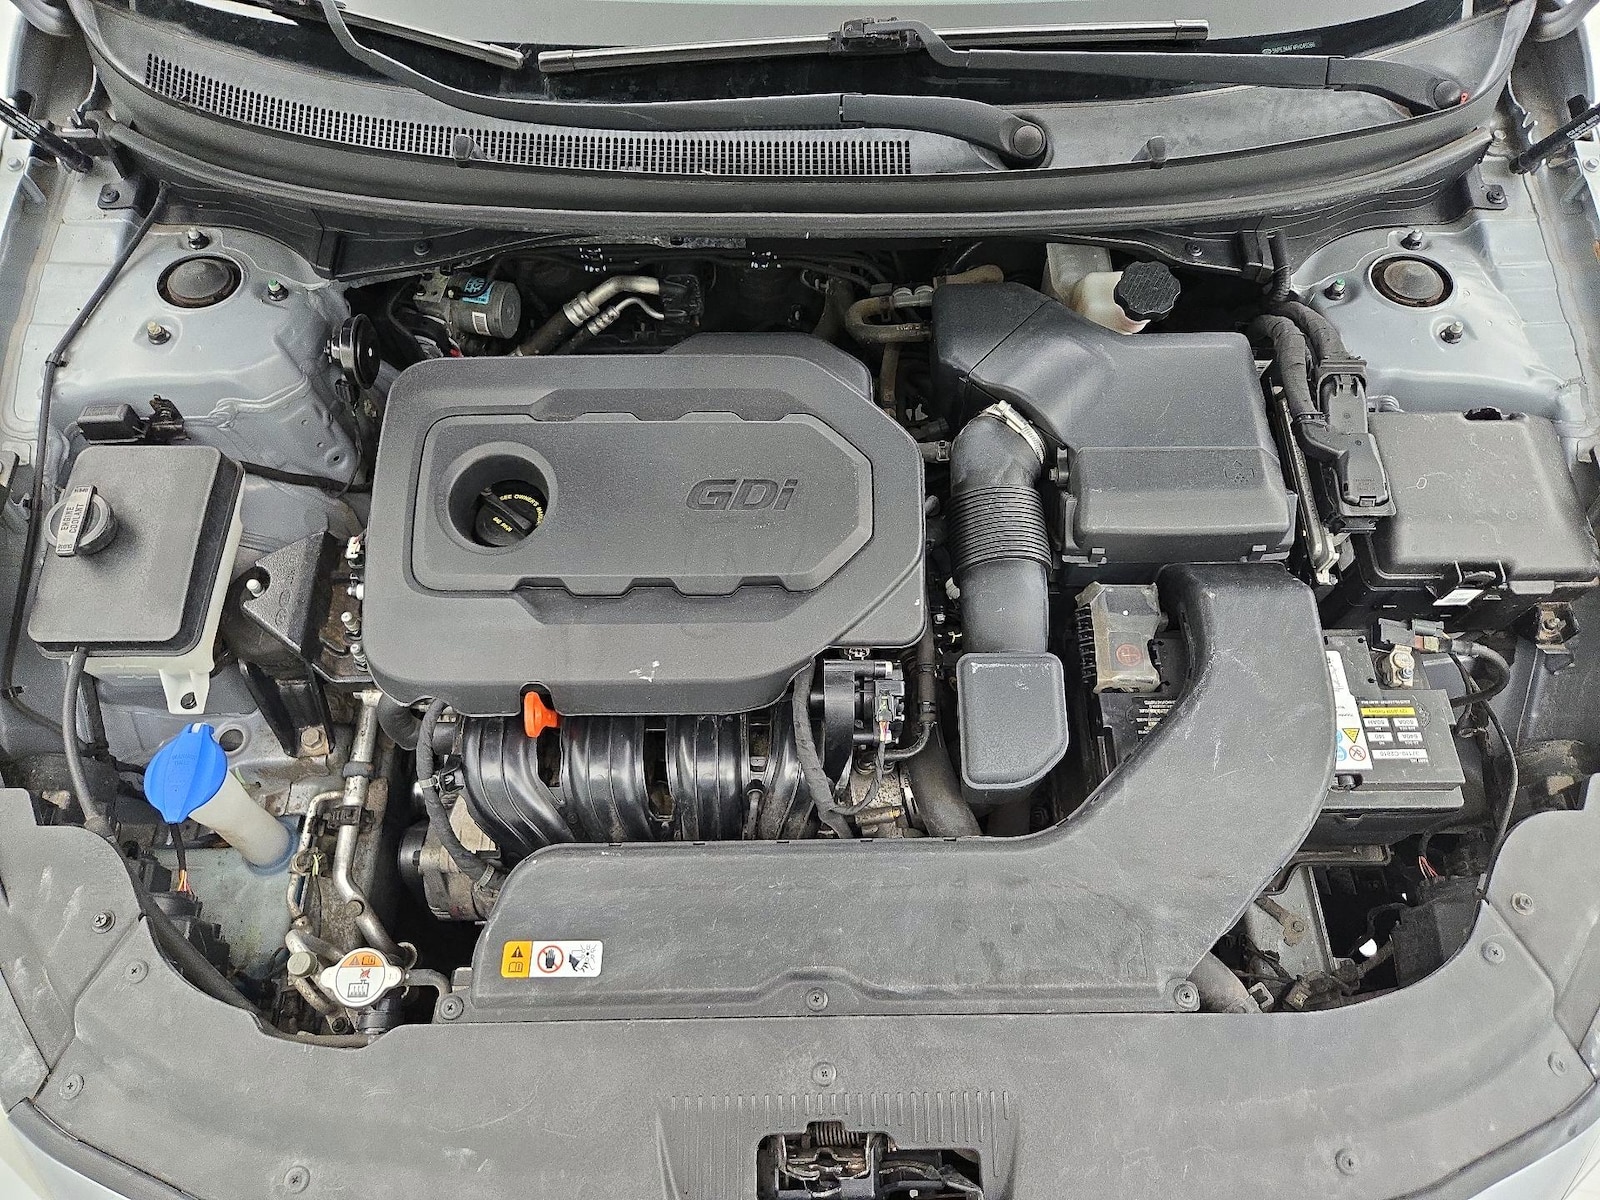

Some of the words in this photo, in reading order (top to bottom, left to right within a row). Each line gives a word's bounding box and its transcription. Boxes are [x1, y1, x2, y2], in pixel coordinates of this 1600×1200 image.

[685, 478, 798, 511] GDi
[60, 506, 75, 531] ENGINE
[69, 503, 84, 534] COOLANT
